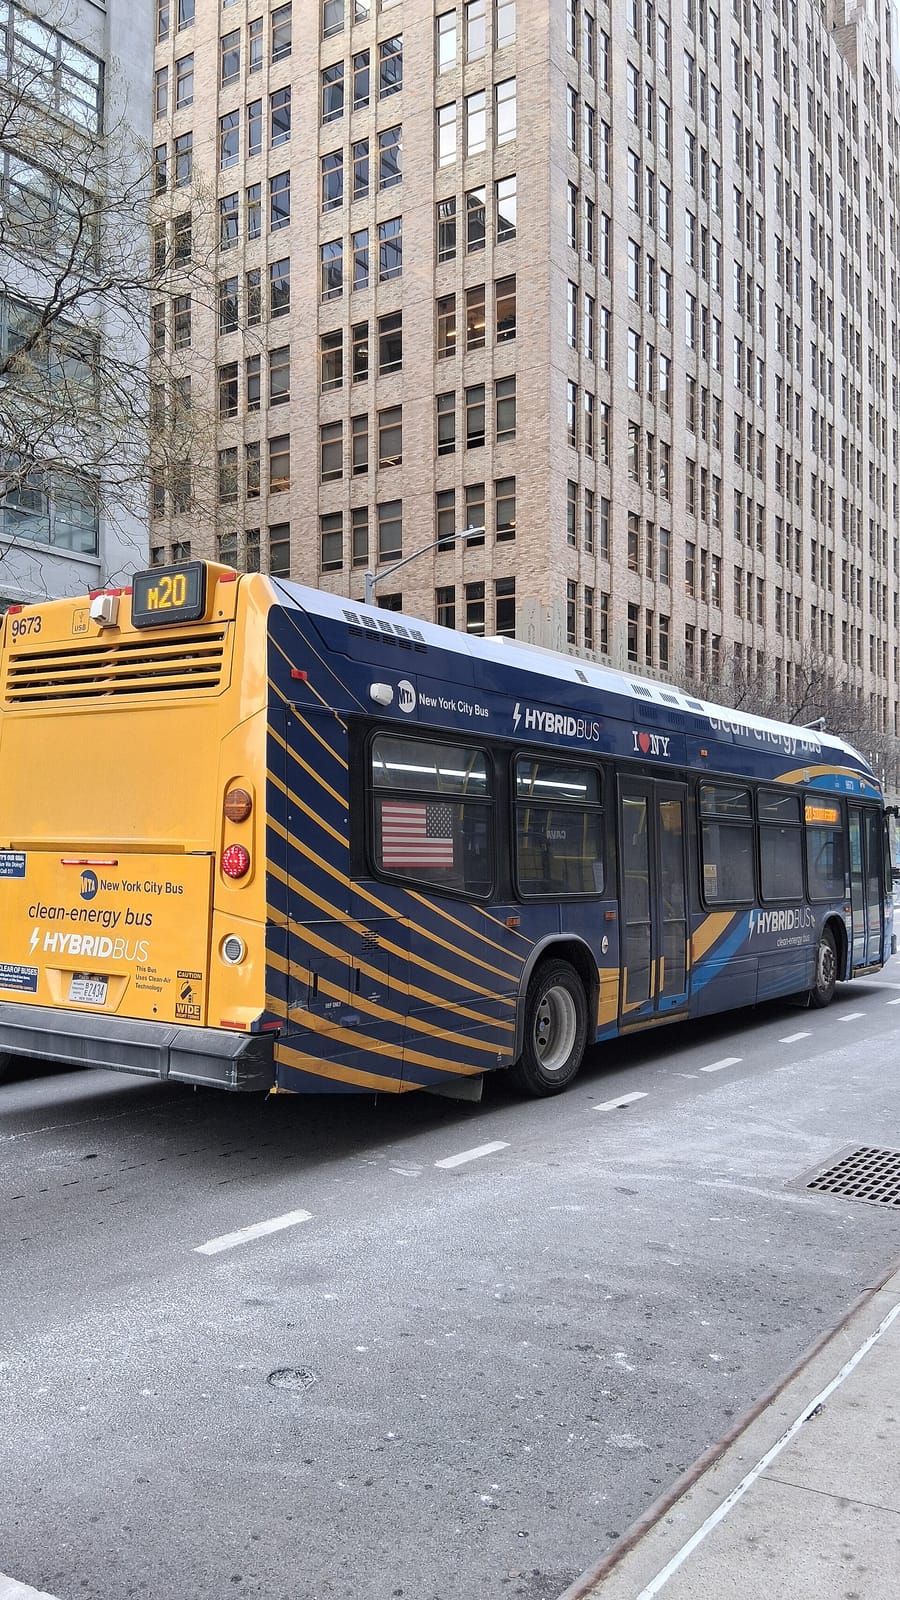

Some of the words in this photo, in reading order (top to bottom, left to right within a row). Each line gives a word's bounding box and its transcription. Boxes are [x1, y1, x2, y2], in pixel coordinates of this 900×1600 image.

[147, 573, 186, 610] M20
[11, 615, 42, 637] 9673
[74, 623, 87, 632] USB
[419, 693, 437, 707] New
[438, 697, 456, 711] York
[457, 700, 473, 716] City
[474, 704, 489, 717] Bus
[524, 708, 600, 742] HYBRIDBUS
[631, 730, 640, 751] I
[649, 733, 670, 757] NY
[100, 880, 119, 891] New
[121, 880, 141, 892] York
[144, 881, 162, 895] City
[165, 882, 184, 895] Bus
[28, 902, 121, 928] clean-energy
[125, 907, 153, 926] bus
[757, 907, 811, 935] HYBRIDBUS
[43, 931, 150, 962] HYBRIDBUS
[178, 971, 201, 979] CAUTION
[177, 1003, 200, 1016] WIDE
